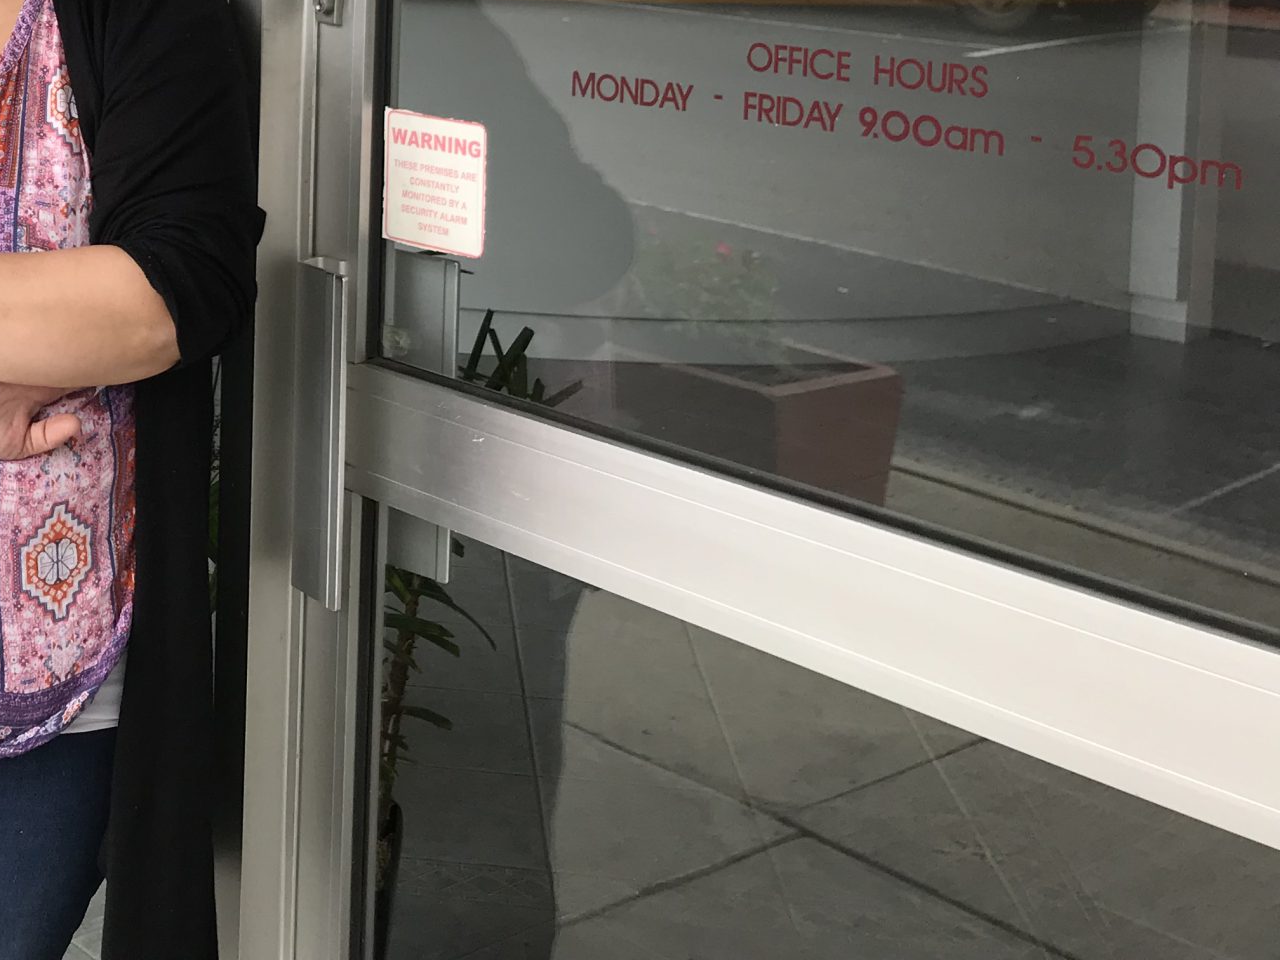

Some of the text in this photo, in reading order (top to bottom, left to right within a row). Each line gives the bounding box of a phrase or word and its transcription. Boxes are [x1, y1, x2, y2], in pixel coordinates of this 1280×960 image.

[747, 41, 990, 100] OFFICE HOURS
[571, 70, 694, 112] MONDAY
[742, 91, 843, 134] FRIDAY
[860, 106, 1006, 157] 9.00am
[1072, 135, 1244, 191] 5.30pm
[392, 127, 481, 158] WARNING
[394, 159, 477, 182] THESE PREMISES ARE
[410, 177, 460, 194] CONSTANTLY
[402, 190, 467, 210] MONITORED BY A
[401, 204, 468, 225] SECURITY ALARM
[418, 223, 449, 236] SYSTEM
